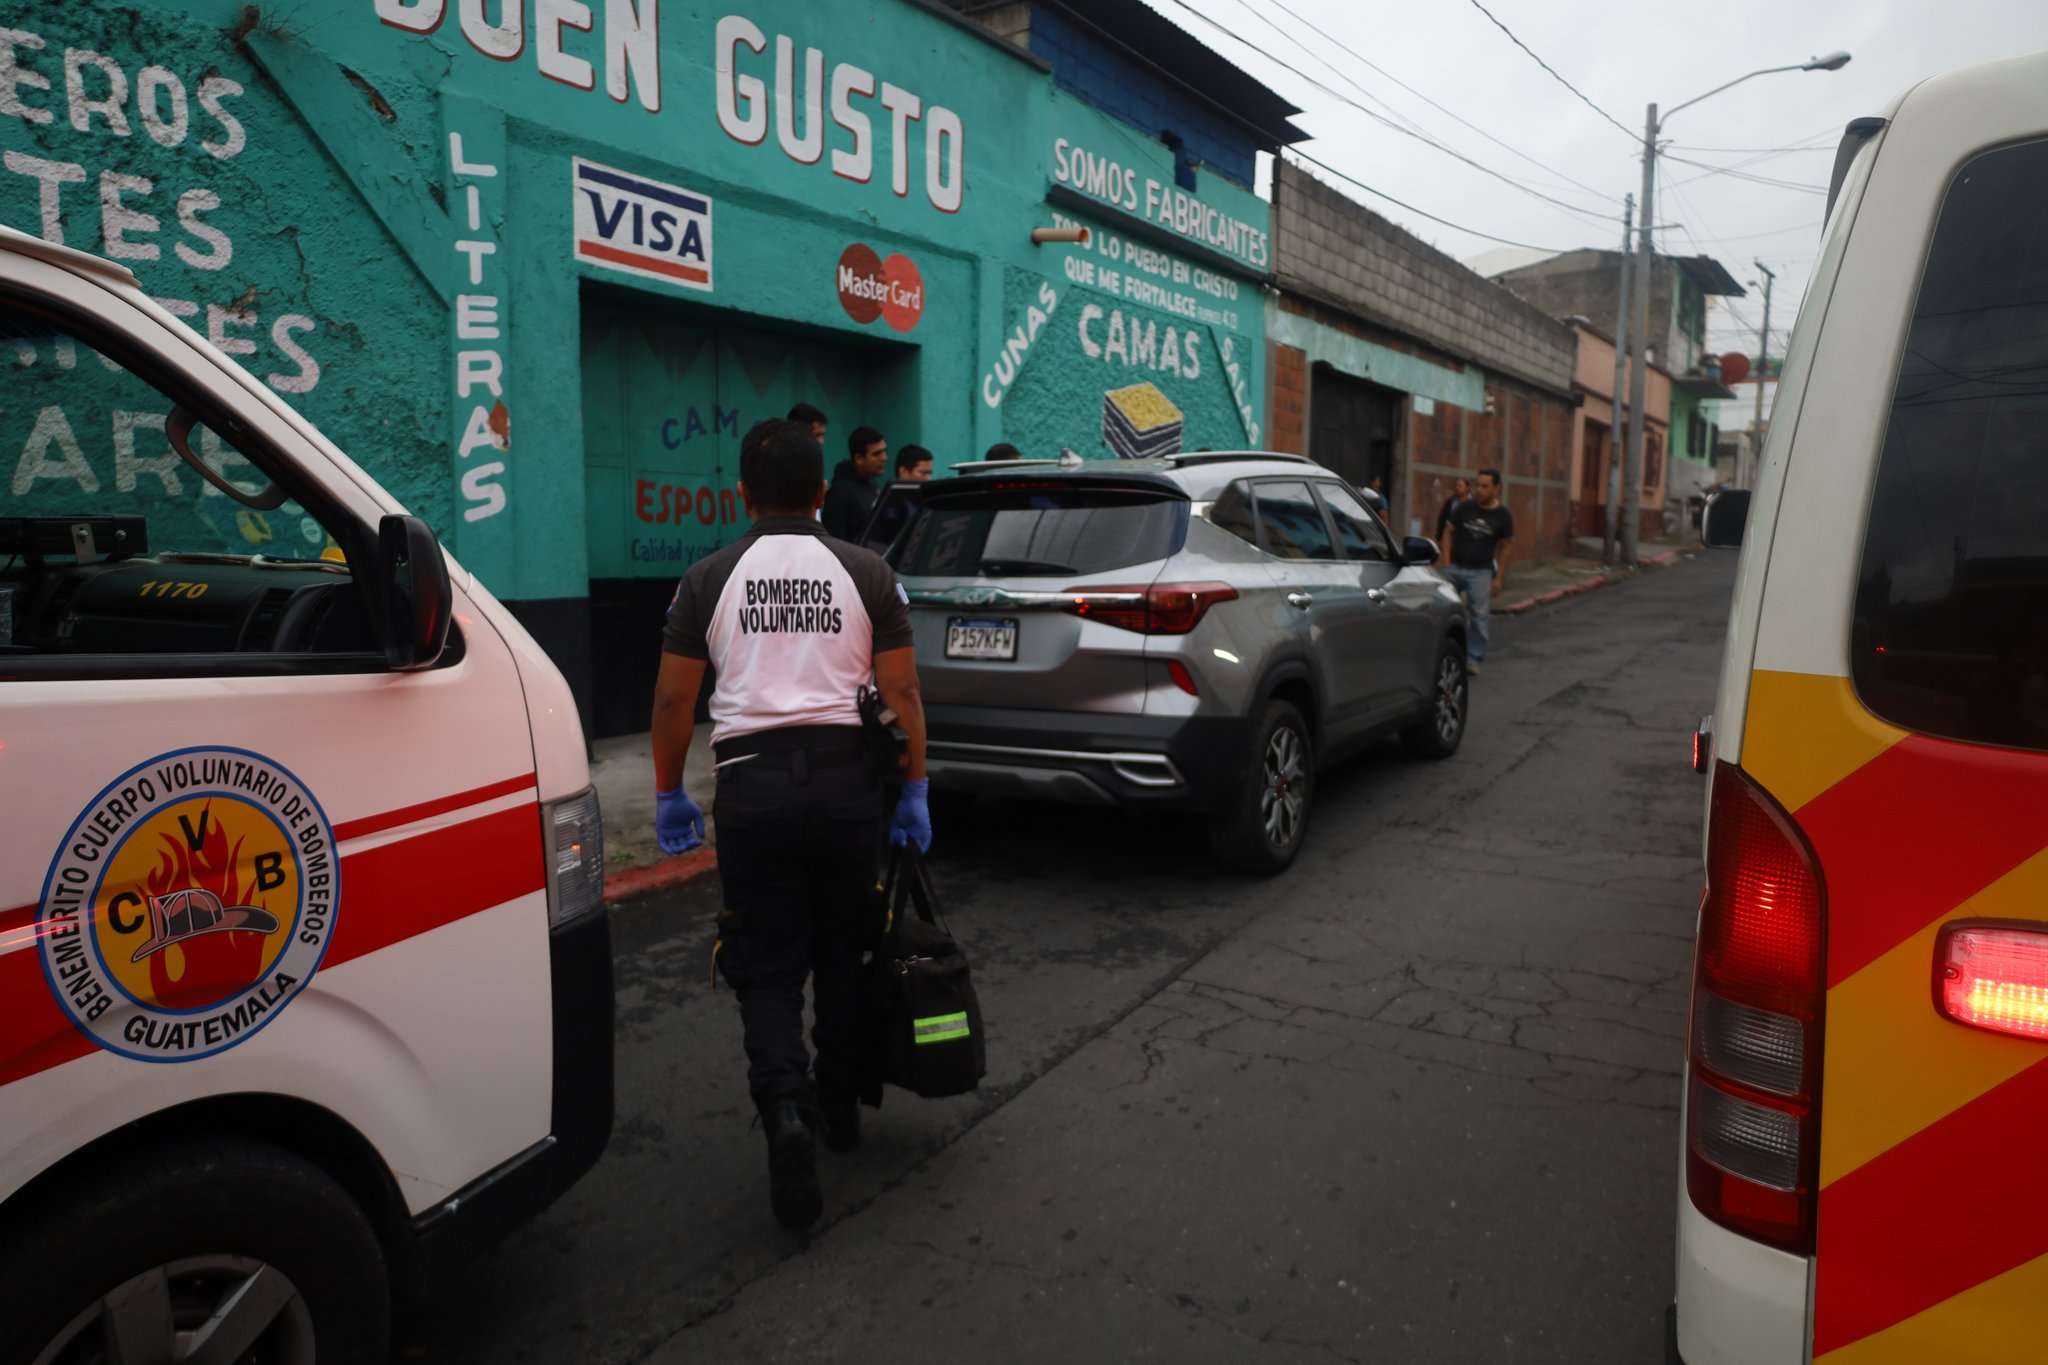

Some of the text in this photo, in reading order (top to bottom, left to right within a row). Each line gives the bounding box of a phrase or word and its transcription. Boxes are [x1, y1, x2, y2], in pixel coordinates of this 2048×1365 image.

[374, 0, 964, 214] EN GUSTO
[579, 187, 705, 262] VISA
[1055, 138, 1267, 267] SOMOS FABRICANTES
[837, 264, 921, 310] Master Card
[1064, 256, 1095, 284] QUE
[1098, 266, 1120, 294] ME
[1125, 277, 1196, 317] FORTALECE
[1099, 231, 1121, 260] LO
[1125, 242, 1170, 277] PUEDO
[1173, 260, 1190, 283] EN
[1193, 268, 1238, 300] CRISTO
[449, 131, 506, 522] LITERAS
[982, 281, 1057, 408] CUNAS
[1078, 304, 1200, 380] CAMAS
[631, 537, 683, 562] Calidad
[138, 581, 209, 600] 1170
[739, 606, 842, 634] VOLUNTARIOS
[746, 579, 832, 605] BOMBEROS
[51, 759, 329, 1021] BENEMERITO CUERPO VOLUNTARIO DE BOMBEROS
[108, 809, 286, 935] C V B
[123, 971, 298, 1050] GUATEMALA
